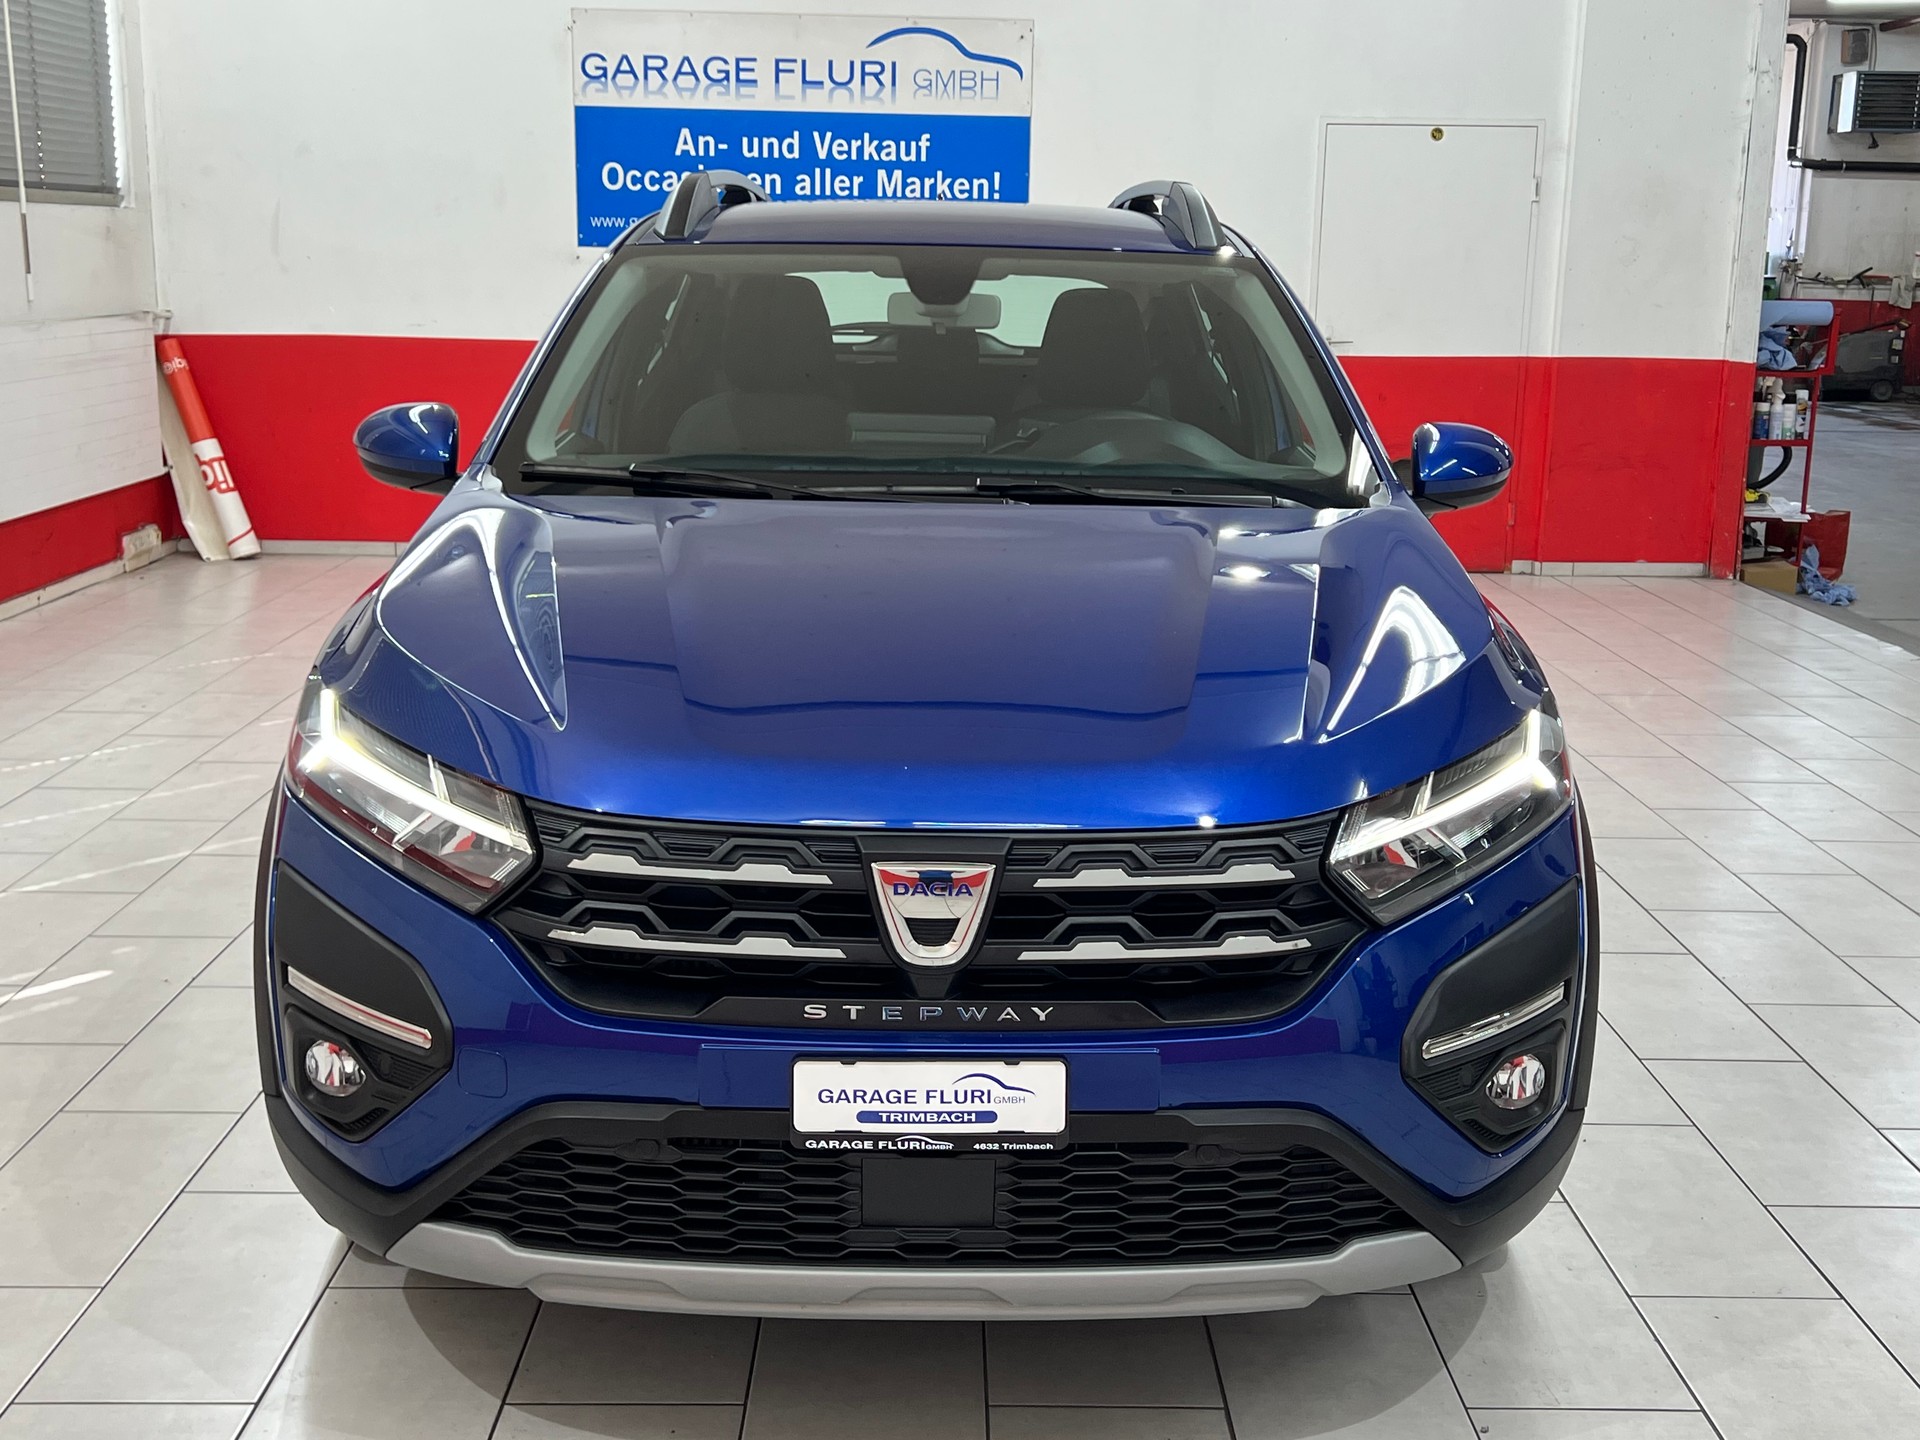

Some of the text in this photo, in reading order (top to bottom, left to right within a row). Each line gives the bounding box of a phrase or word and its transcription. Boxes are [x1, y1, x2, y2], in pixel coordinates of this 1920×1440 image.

[580, 53, 1000, 91] GARAGE FLURI GMBH
[675, 128, 931, 162] An- und Verkauf
[601, 162, 1001, 200] Occaen aller Marken!
[893, 882, 973, 897] DACIA
[803, 1004, 1054, 1022] STEPWAY
[817, 1088, 1026, 1104] GARAGE FLURI GMBH
[878, 1113, 976, 1123] TRIMBACH
[805, 1140, 874, 1150] GARAGE
[879, 1140, 925, 1150] FLURI
[1002, 1142, 1054, 1150] Trimbach
